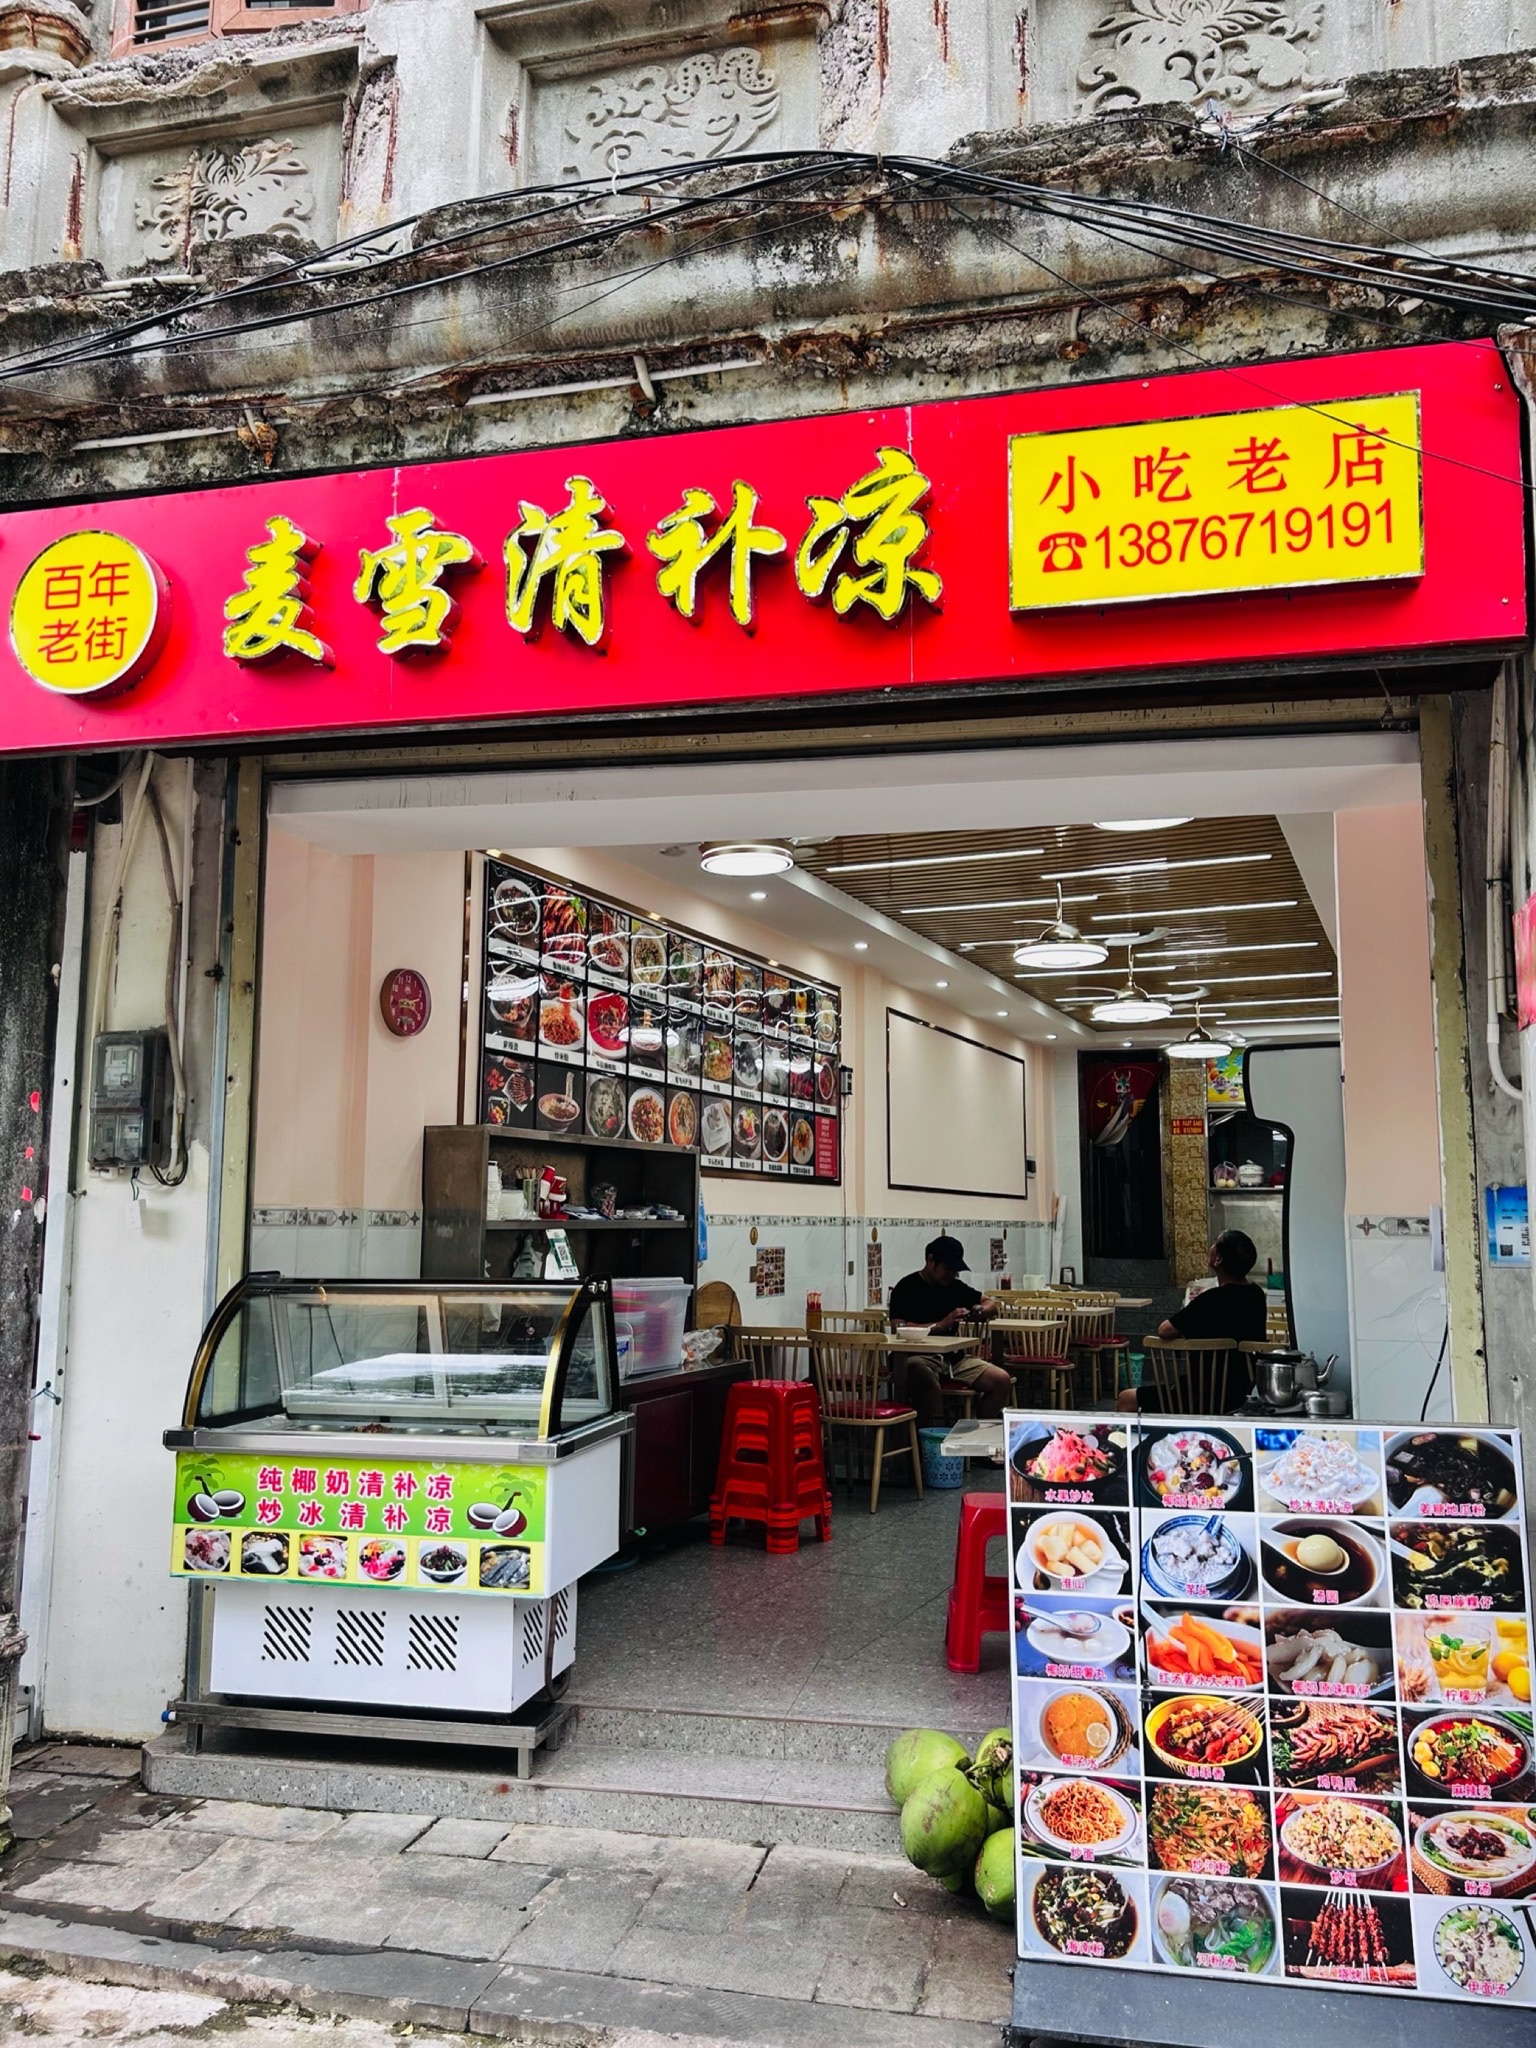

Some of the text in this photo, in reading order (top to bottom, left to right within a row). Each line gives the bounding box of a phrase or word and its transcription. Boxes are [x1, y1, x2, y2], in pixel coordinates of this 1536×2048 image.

[1040, 423, 1391, 514] 小吃老店
[1094, 498, 1394, 570] 13876719191
[223, 446, 943, 661] 麦雪清补凉
[44, 560, 130, 610] 百年
[38, 616, 128, 663] 老街
[256, 1466, 454, 1501] 纯椰奶清补凉
[1045, 1489, 1094, 1503] 水果炒冰
[1162, 1493, 1225, 1509] 椰奶清补凉
[1289, 1499, 1353, 1514] 炒冰清补凉
[255, 1498, 453, 1534] 炒冰清补凉
[1061, 1577, 1085, 1590] 淮山
[1186, 1584, 1209, 1597] 芋头
[1313, 1590, 1339, 1604] 汤圆
[1445, 1689, 1486, 1702] 柠檬水
[1187, 1766, 1225, 1781] 串串香
[1451, 1784, 1492, 1799] 麻辣烫
[1070, 1847, 1095, 1861] 炒面
[1191, 1858, 1231, 1875] 炒河粉
[1330, 1870, 1358, 1887] 炒饭
[1464, 1880, 1492, 1896] 粉汤
[1067, 1939, 1105, 1957] 海南粉
[1197, 1953, 1236, 1969] 河粉汤
[1337, 1968, 1363, 1982] 烧烤
[1467, 1980, 1507, 1996] 伊面汤
